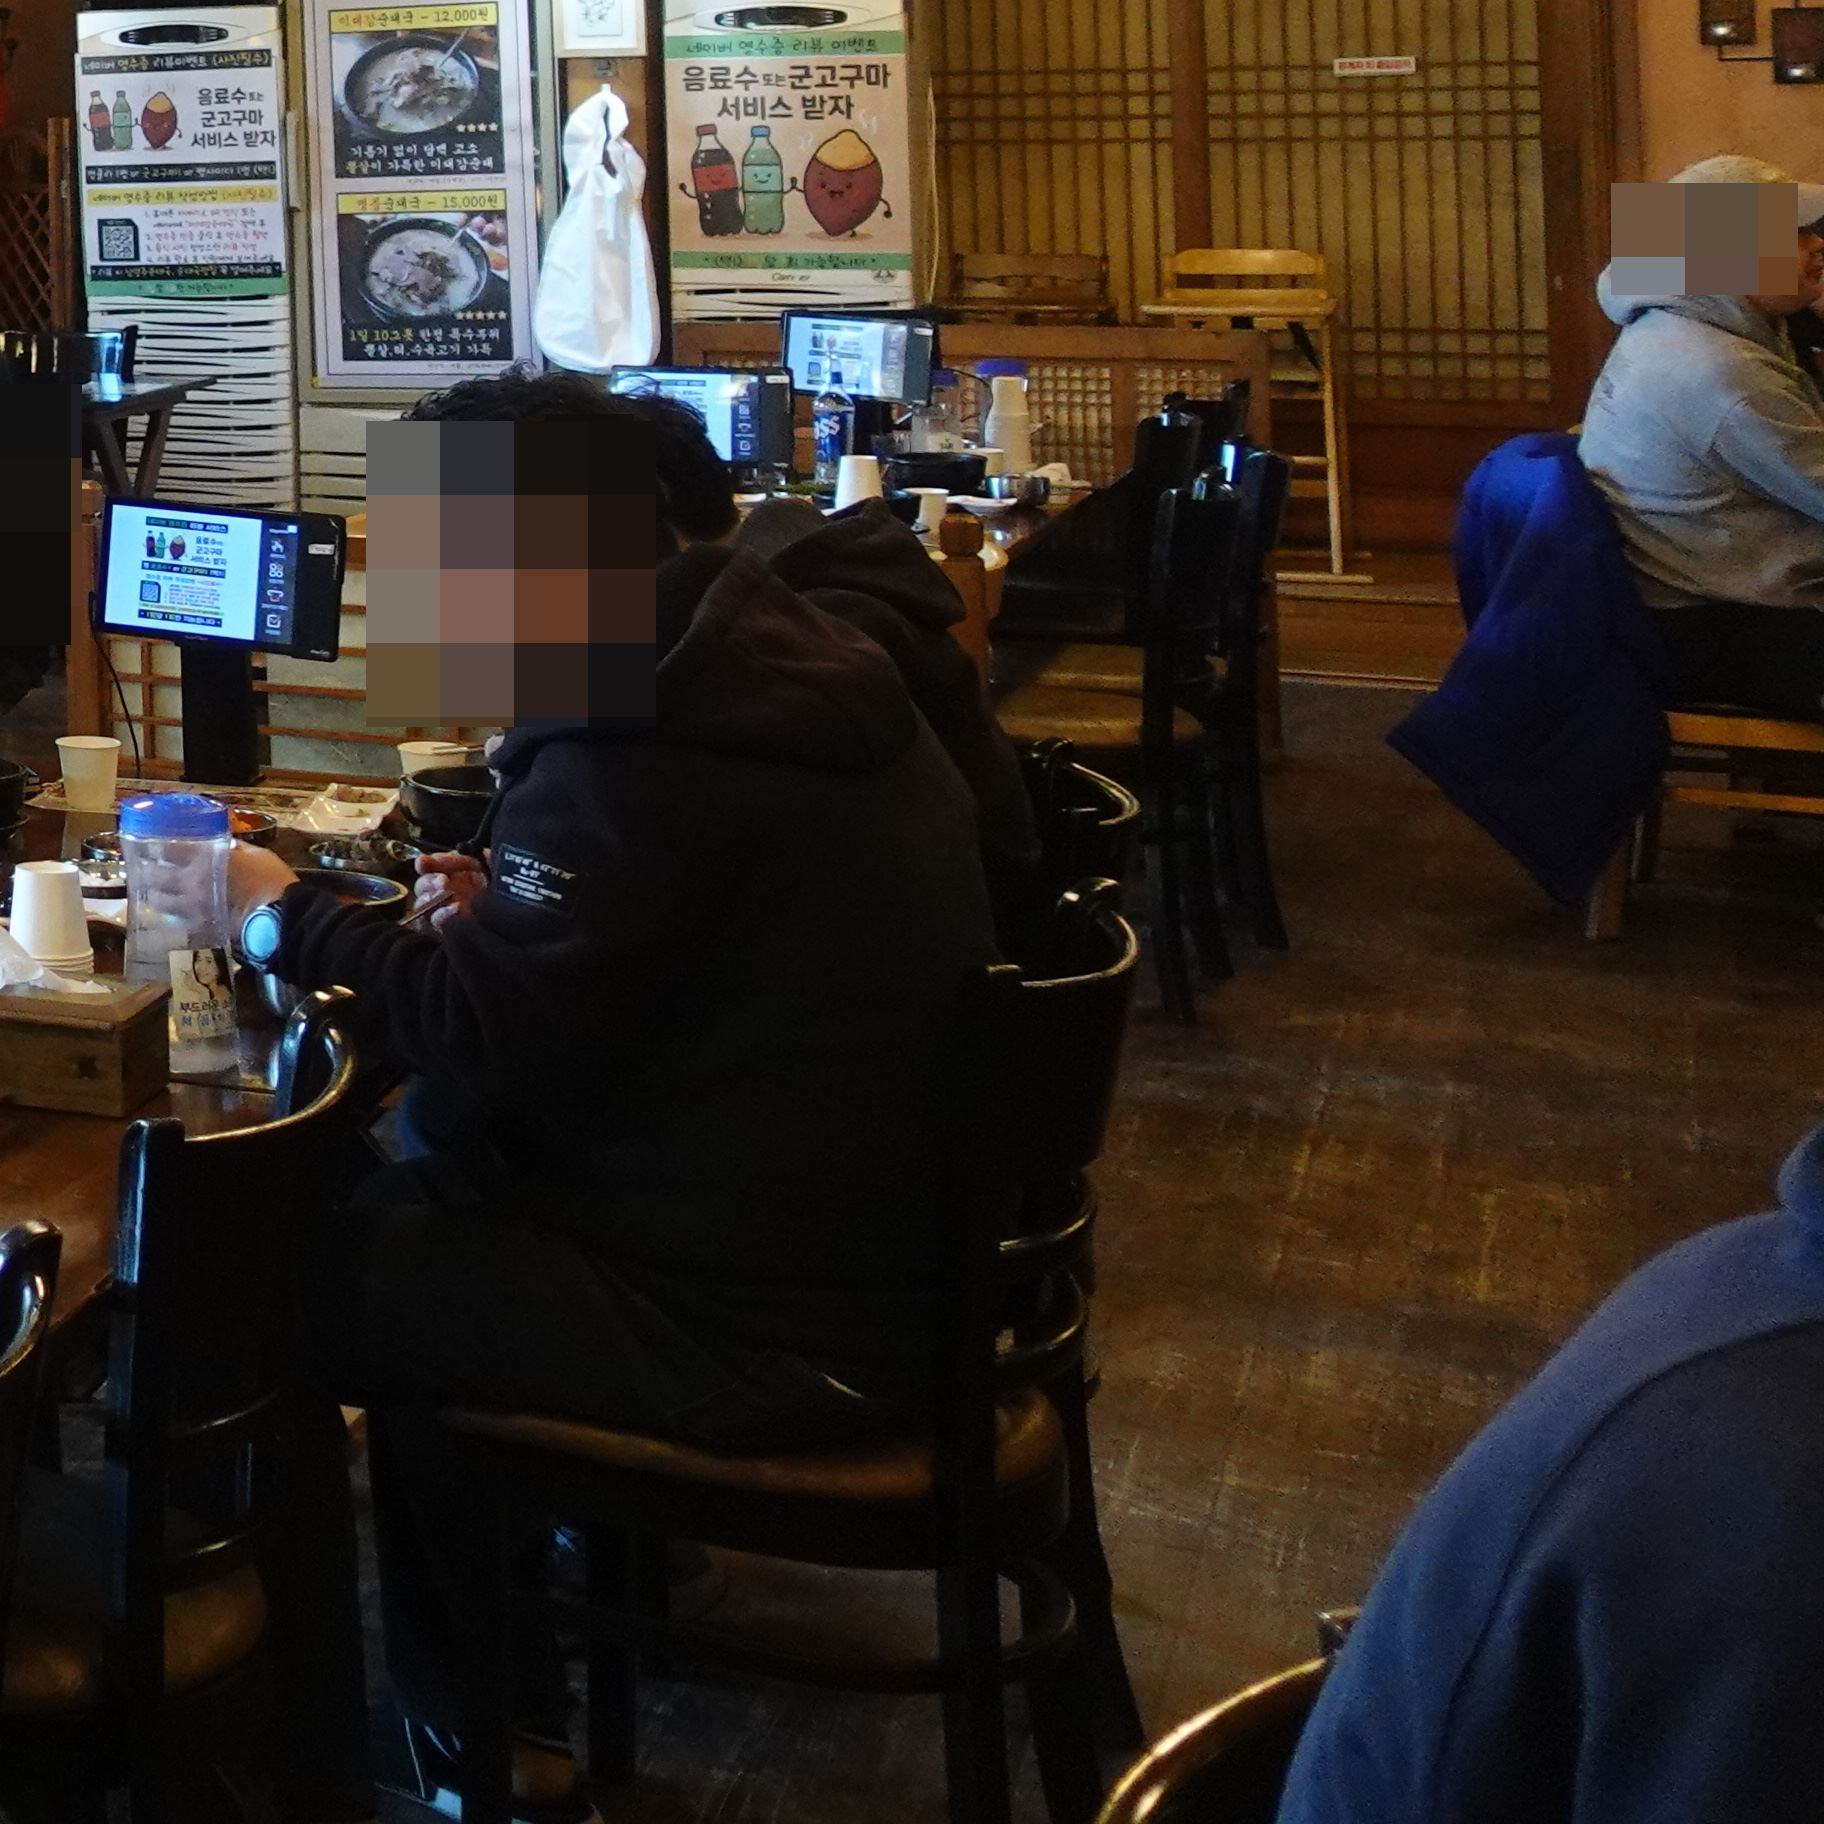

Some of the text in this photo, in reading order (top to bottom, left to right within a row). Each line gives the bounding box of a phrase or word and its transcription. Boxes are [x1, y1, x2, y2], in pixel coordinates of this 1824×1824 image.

[686, 37, 880, 56] 네이버 영수증 리뷰 이벤트
[683, 64, 891, 92] 음료수 또는 군고구마
[196, 87, 248, 106] 음료수
[717, 94, 856, 121] 서비스 받자
[200, 109, 264, 127] 군고구마
[190, 129, 276, 149] 서비스 받자
[350, 144, 388, 159] 기름기
[392, 143, 418, 158] 없이
[453, 143, 480, 155] 고소
[387, 158, 426, 173] 가득한
